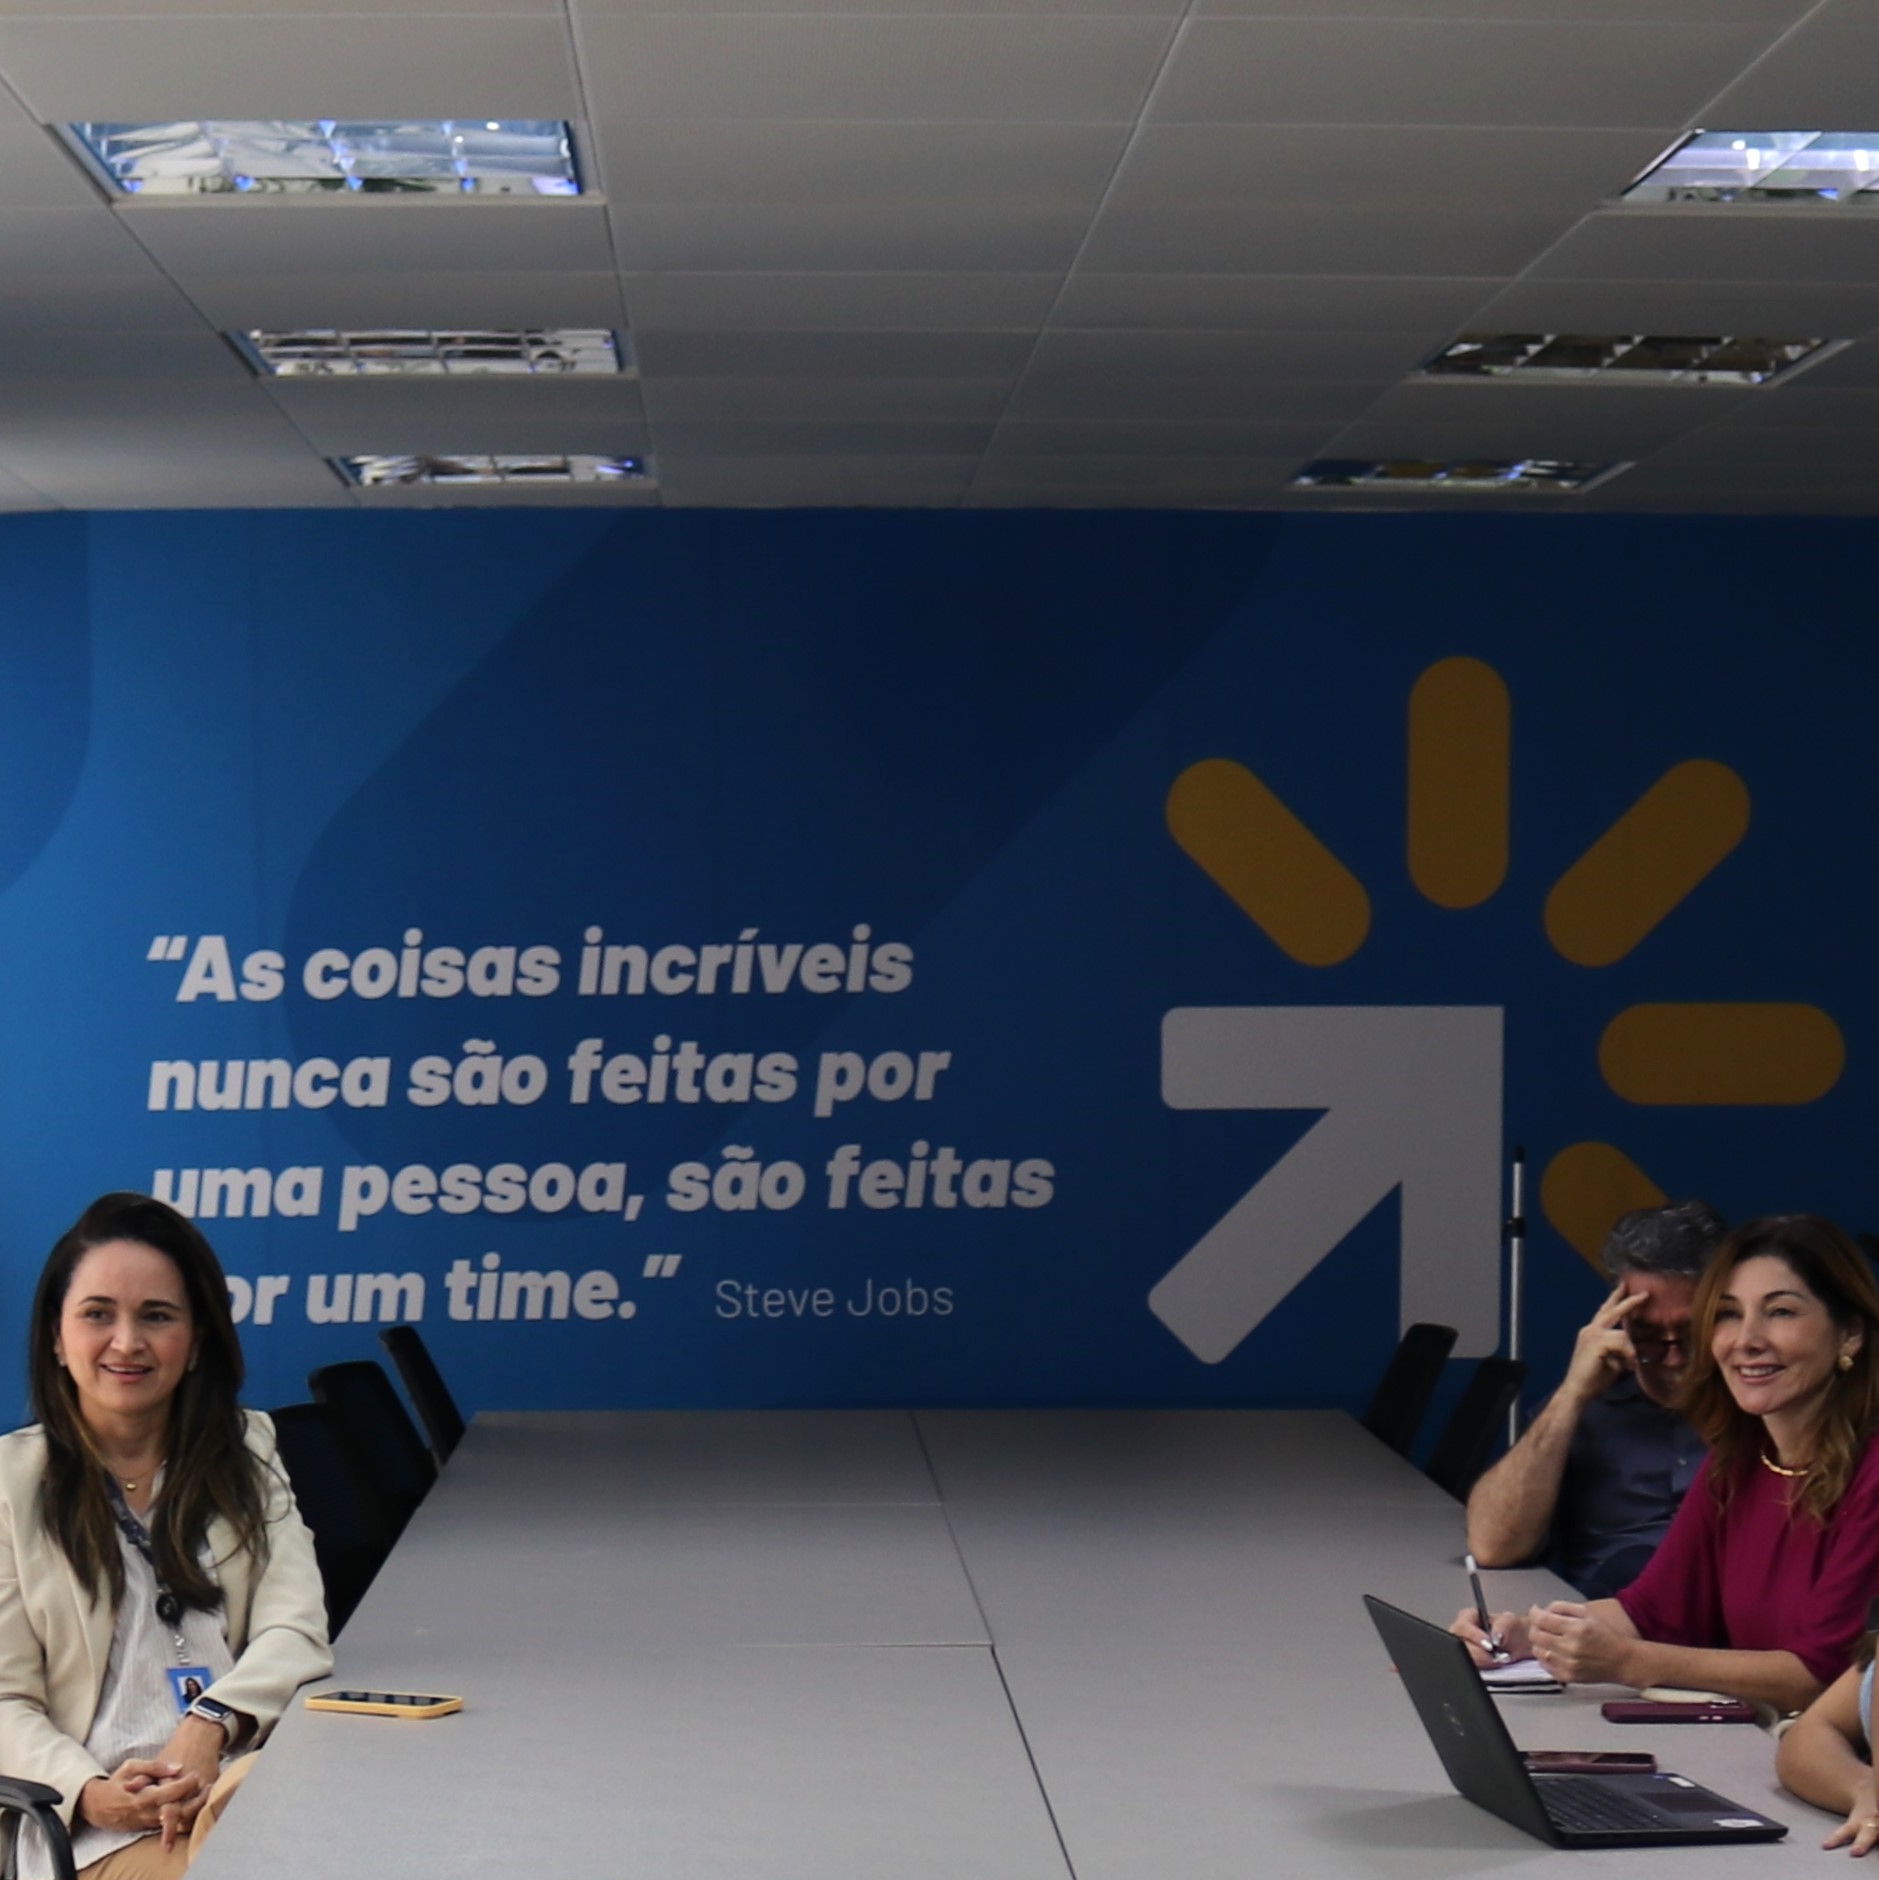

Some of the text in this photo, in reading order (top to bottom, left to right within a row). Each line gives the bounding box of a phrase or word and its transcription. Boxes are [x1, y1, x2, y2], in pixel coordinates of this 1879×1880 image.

[302, 927, 562, 1000] coisas
[577, 923, 915, 996] incríveis
[147, 1034, 952, 1118] nunca são feitas por
[152, 1140, 1056, 1232] uma pessoa, são feitas
[306, 1271, 426, 1325] um
[715, 1278, 954, 1319] Steve Jobs
